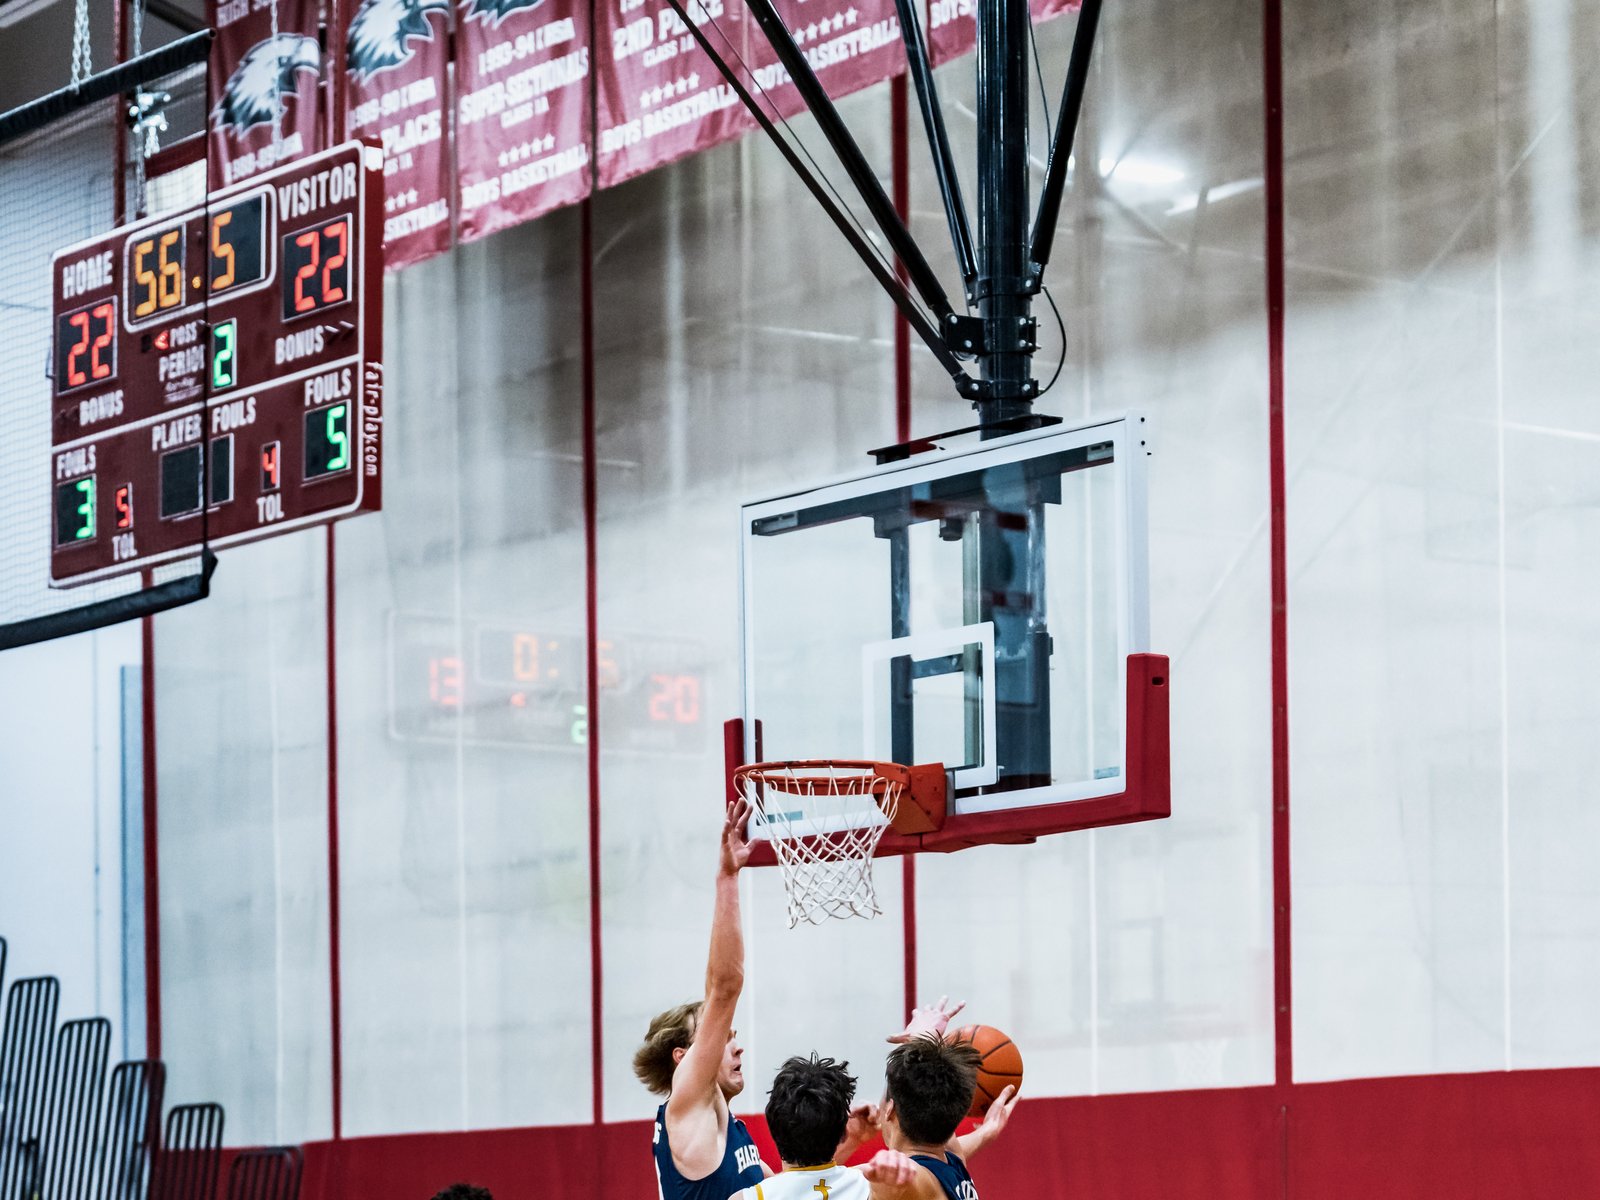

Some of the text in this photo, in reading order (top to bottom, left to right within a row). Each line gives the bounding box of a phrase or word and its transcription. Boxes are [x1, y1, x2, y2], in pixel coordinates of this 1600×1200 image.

[612, 16, 654, 61] 2ND
[381, 109, 442, 157] PLACE
[278, 162, 357, 222] VISITOR
[383, 197, 449, 243] SKETBALL
[62, 250, 114, 300] HOME
[294, 221, 347, 312] 22
[68, 303, 114, 387] 22
[169, 321, 198, 348] POSS
[213, 323, 234, 388] 2
[274, 325, 325, 366] BONUS
[78, 389, 125, 427] BONUS
[304, 368, 351, 407] FOULS
[152, 396, 257, 452] PLAYER FOULS
[326, 404, 348, 471] 5
[56, 444, 97, 480] FOULS
[262, 446, 277, 486] 4
[75, 478, 94, 539] 3
[116, 487, 131, 528] 5
[255, 492, 285, 524] TOL
[111, 531, 138, 562] TOL
[648, 674, 700, 724] 20
[734, 1144, 760, 1175] HAR
